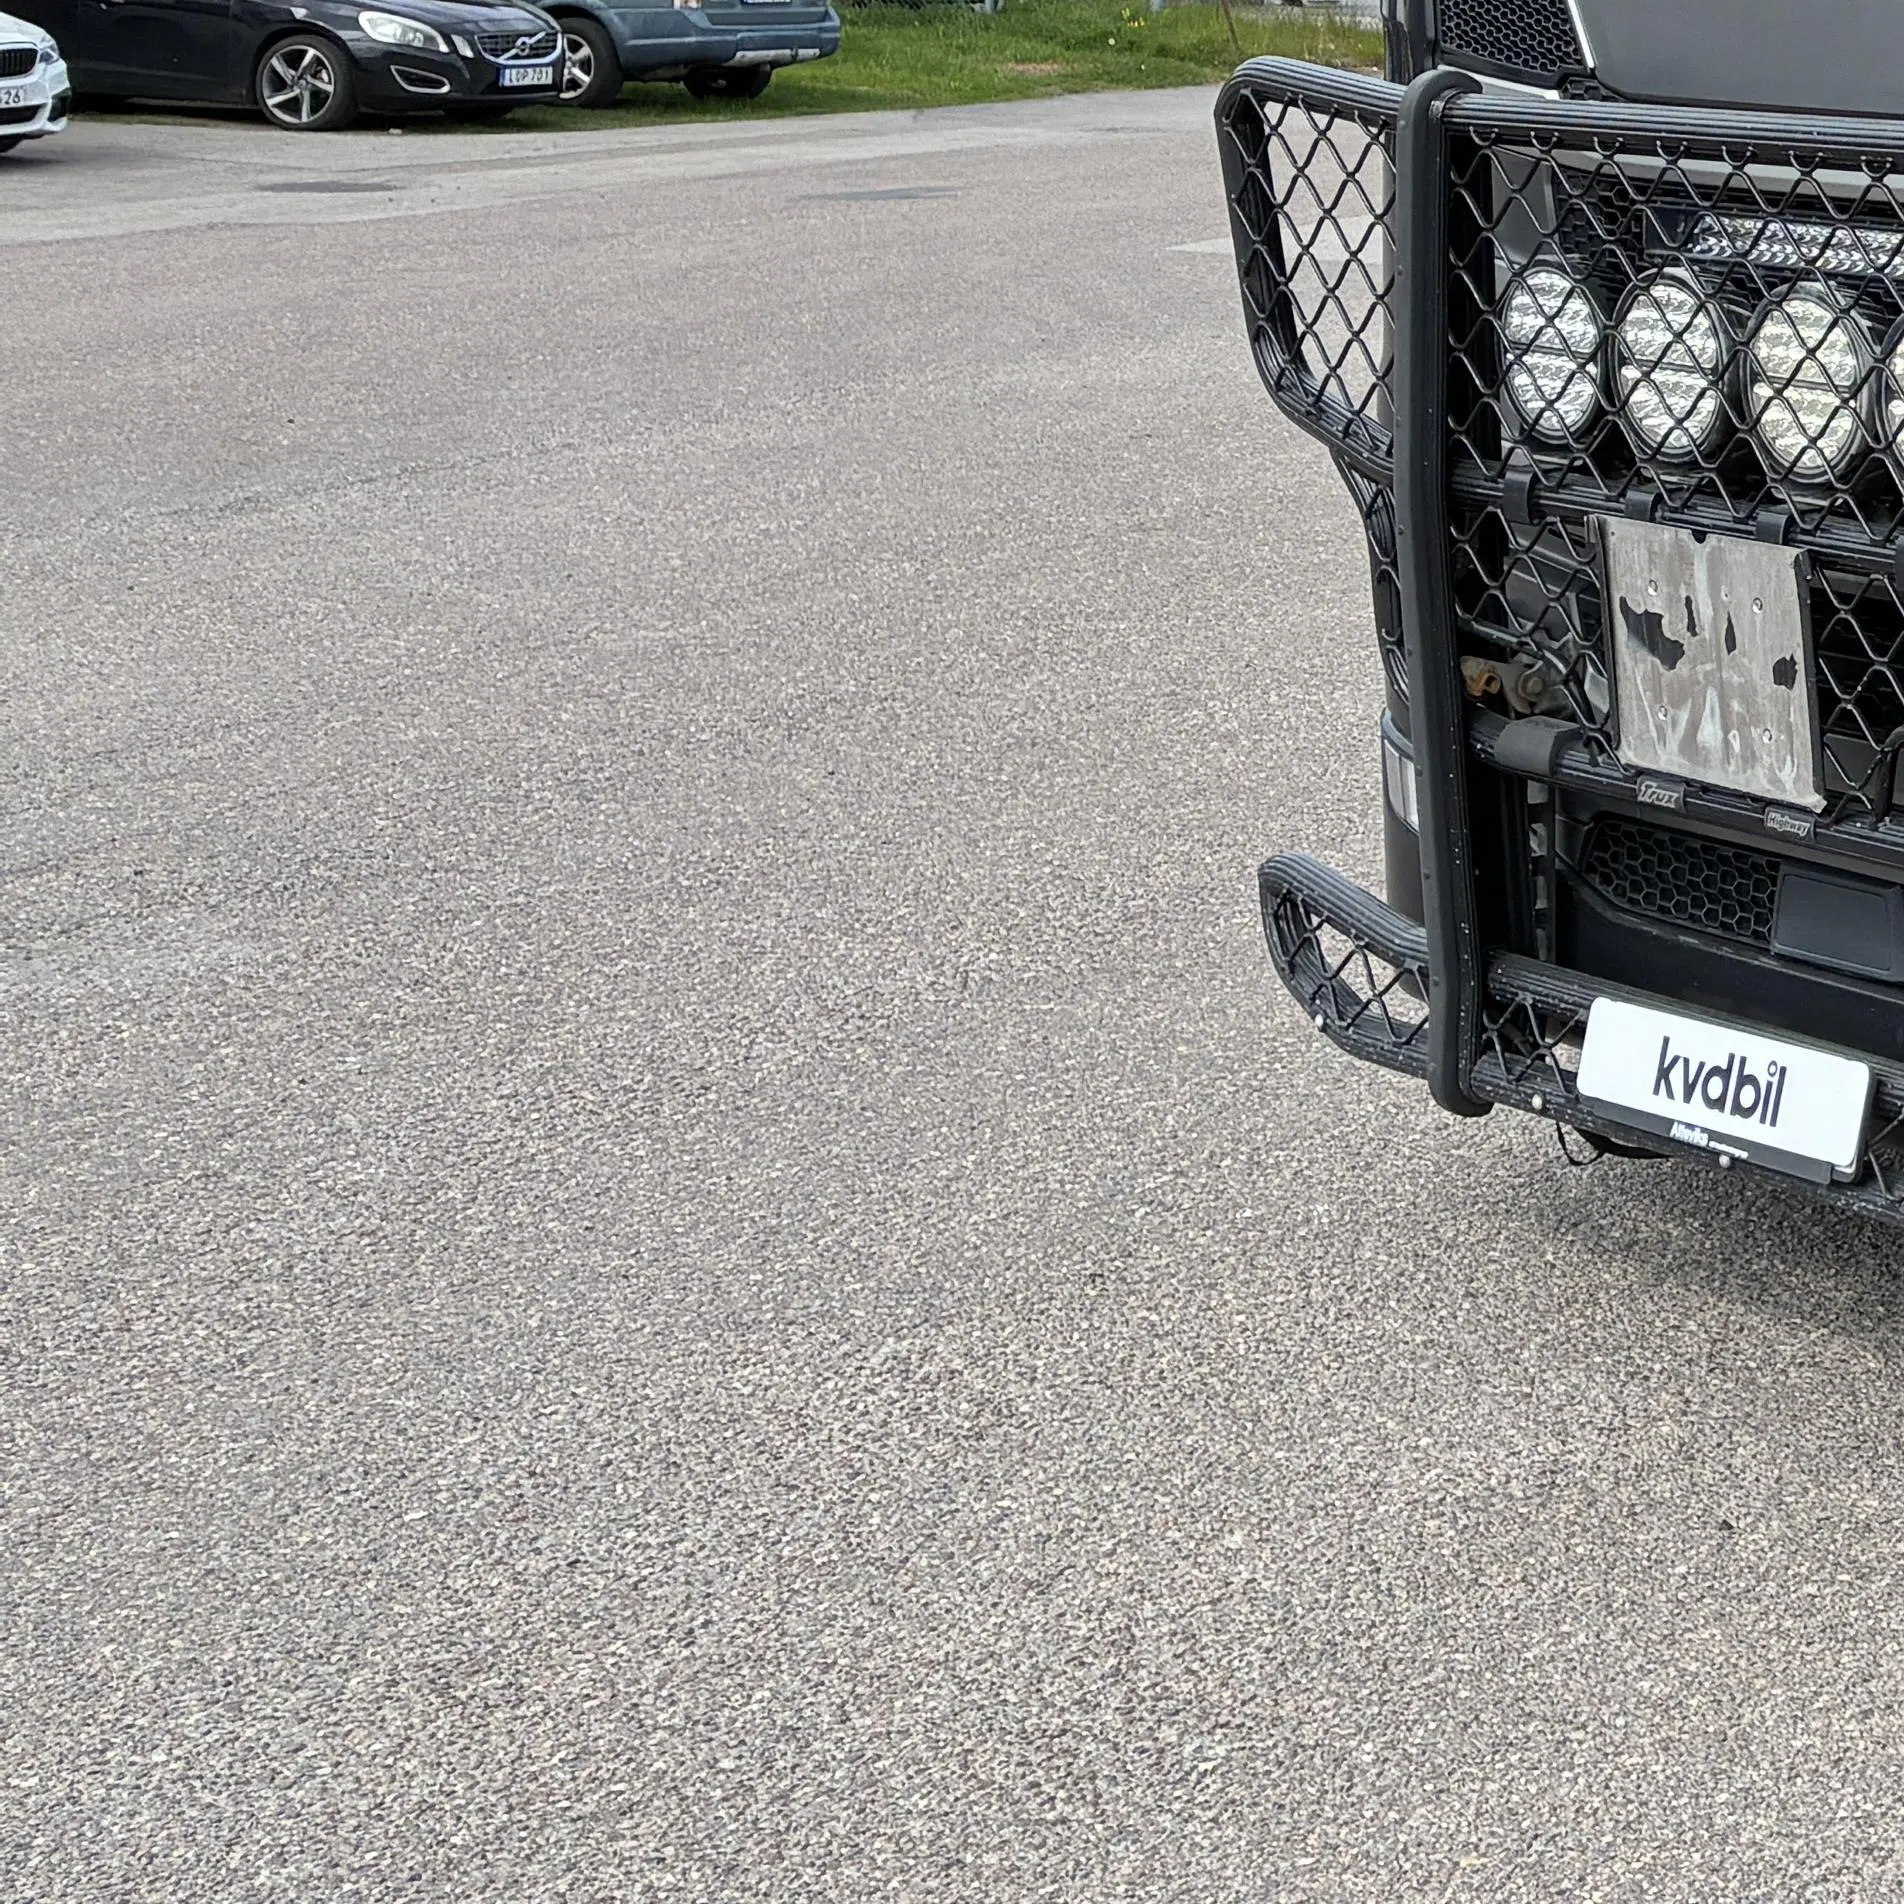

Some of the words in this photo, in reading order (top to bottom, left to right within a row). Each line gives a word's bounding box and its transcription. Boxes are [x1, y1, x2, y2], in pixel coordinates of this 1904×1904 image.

[0, 88, 21, 105] 26
[1767, 811, 1811, 837] Highway
[1652, 1035, 1788, 1127] kvdbil
